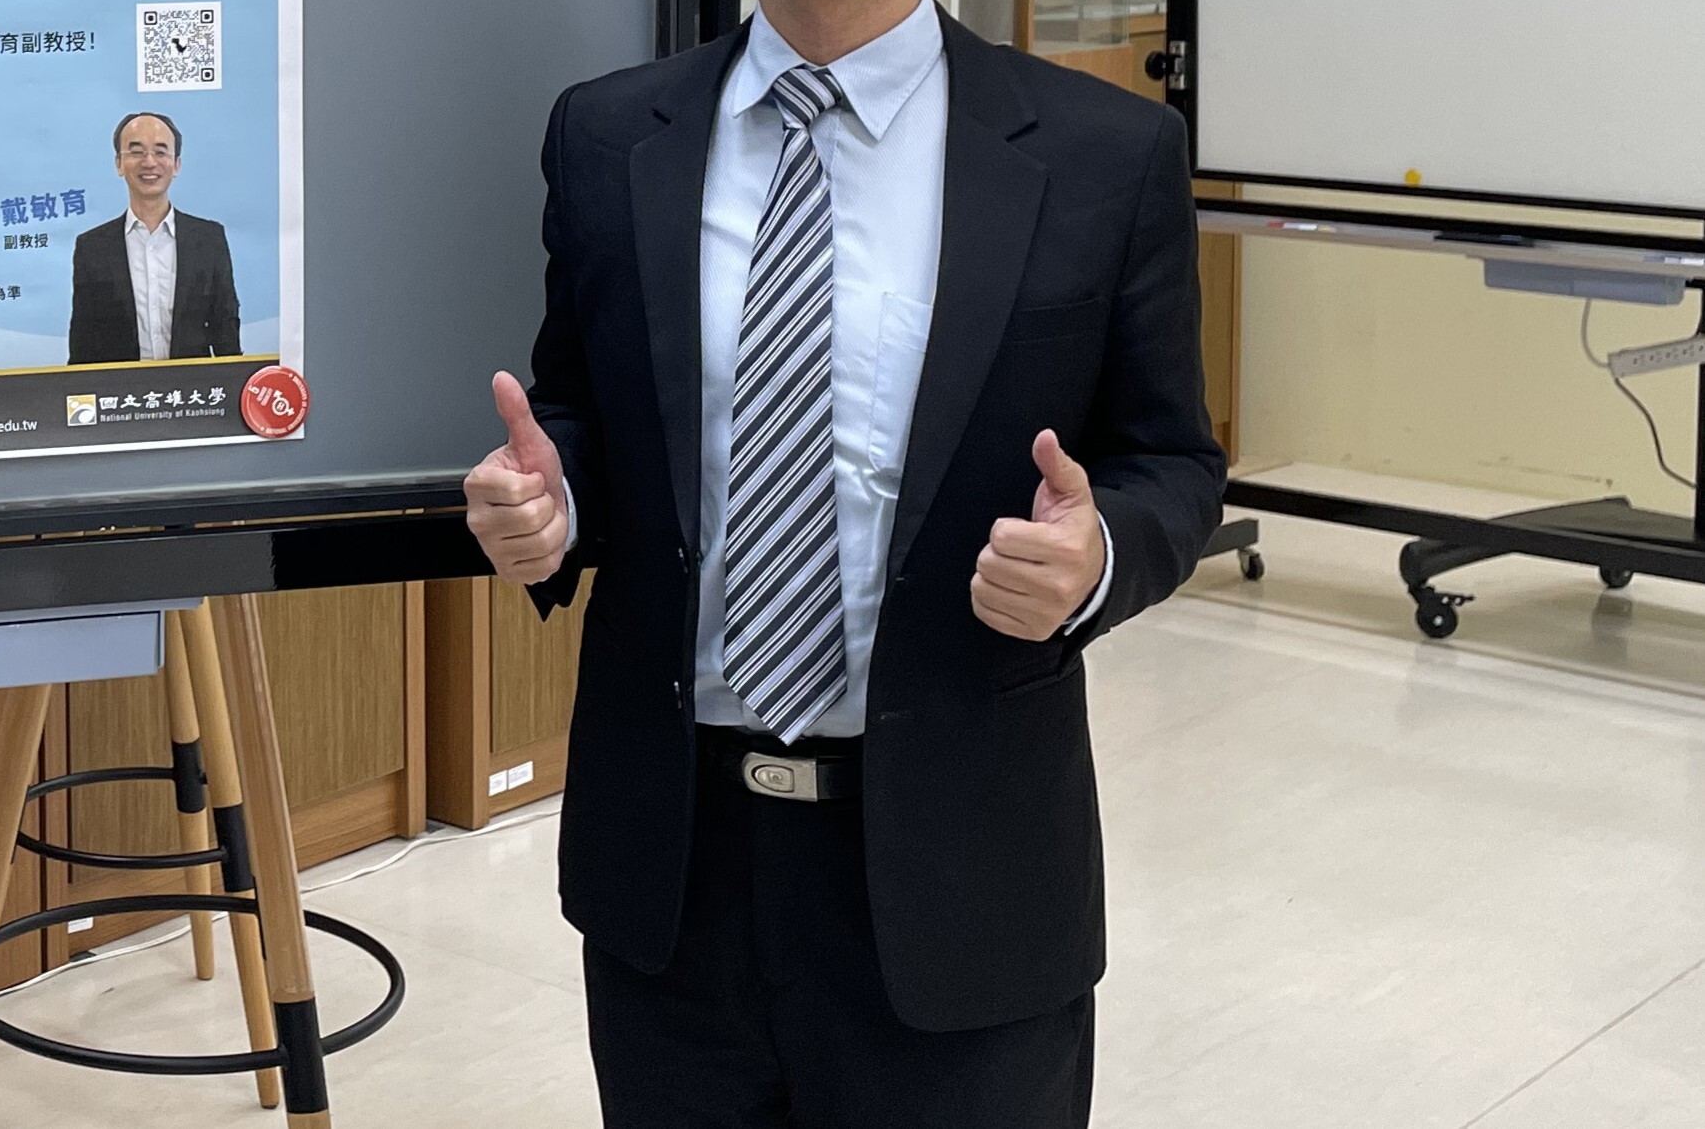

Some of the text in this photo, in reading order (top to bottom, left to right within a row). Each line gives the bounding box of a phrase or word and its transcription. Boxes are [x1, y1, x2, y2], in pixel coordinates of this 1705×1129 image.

[0, 188, 87, 227] 戴敏育
[3, 233, 49, 251] 副教授
[99, 387, 227, 410] 國立高雄大學
[134, 411, 172, 420] University
[175, 409, 184, 418] of
